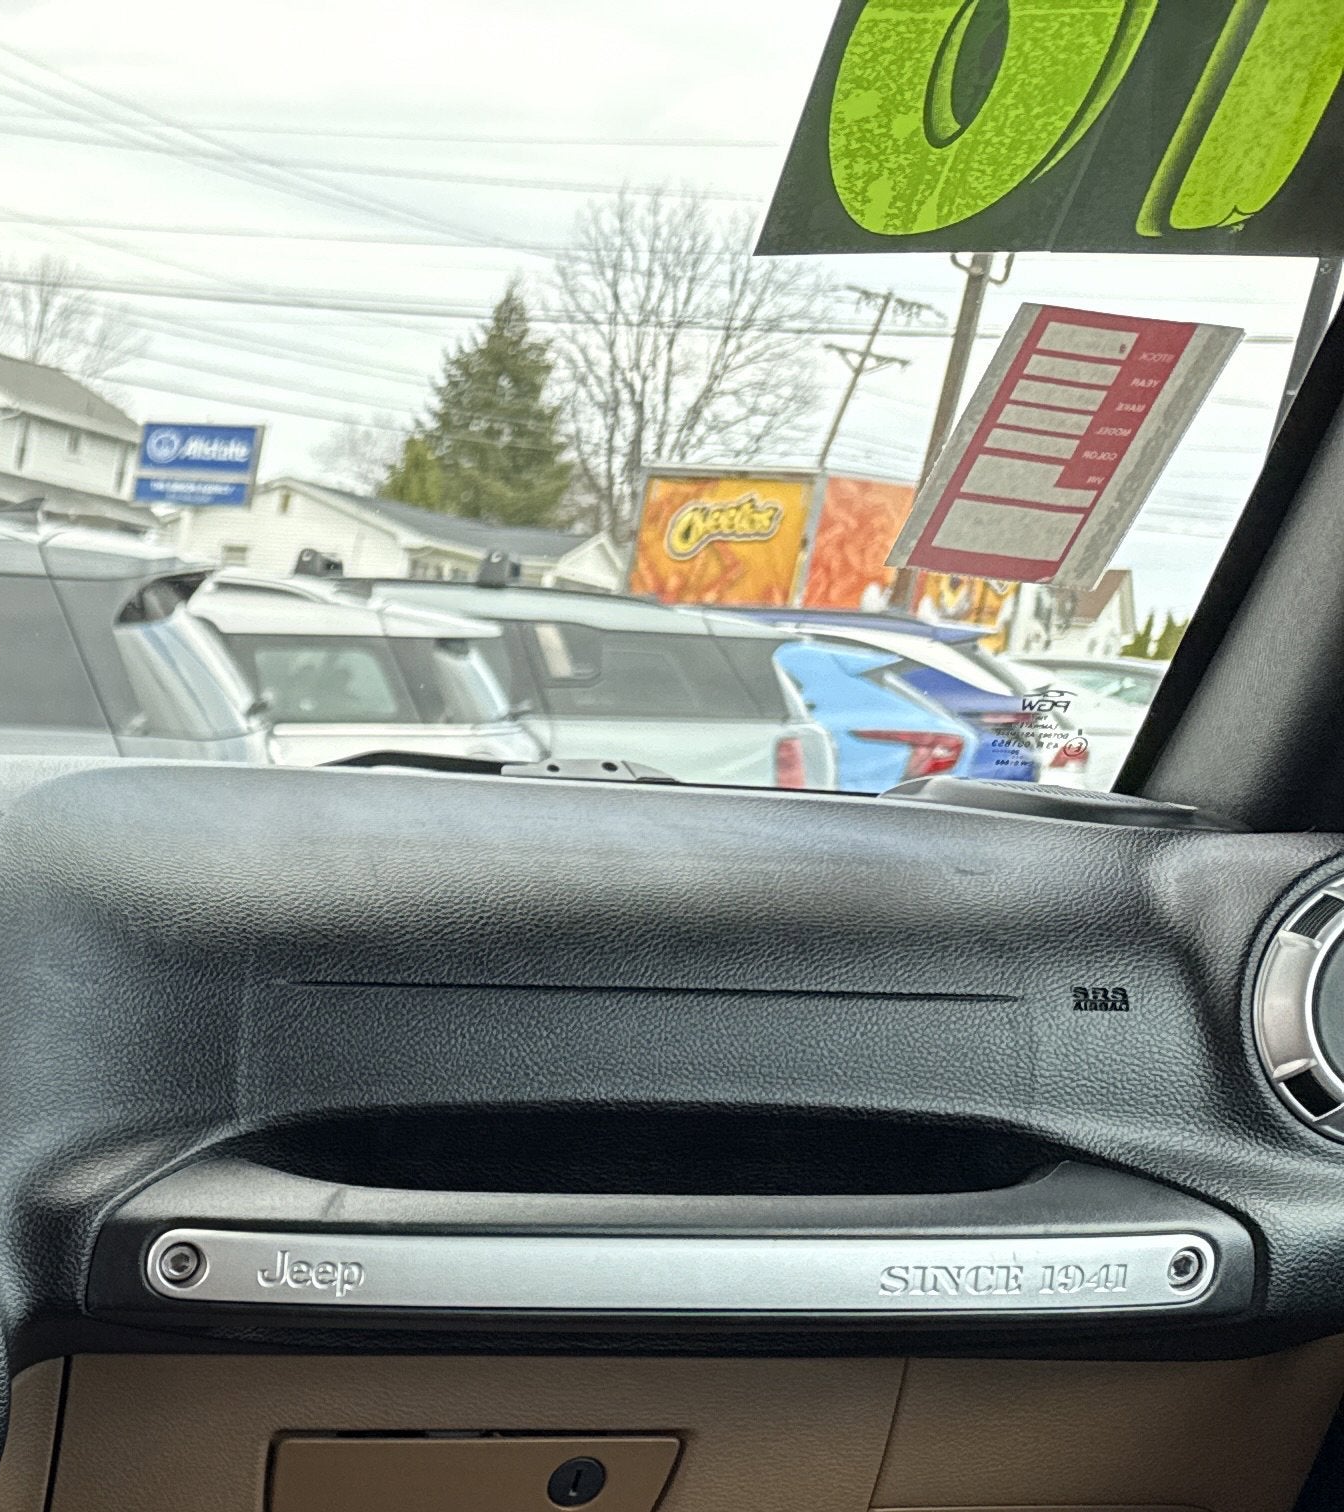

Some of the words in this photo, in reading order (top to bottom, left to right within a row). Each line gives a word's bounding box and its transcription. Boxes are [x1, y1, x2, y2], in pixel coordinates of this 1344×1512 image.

[1072, 987, 1128, 1000] SRS
[257, 1250, 365, 1297] Jeep
[878, 1265, 1023, 1296] SINCE
[1038, 1263, 1128, 1293] 1941
